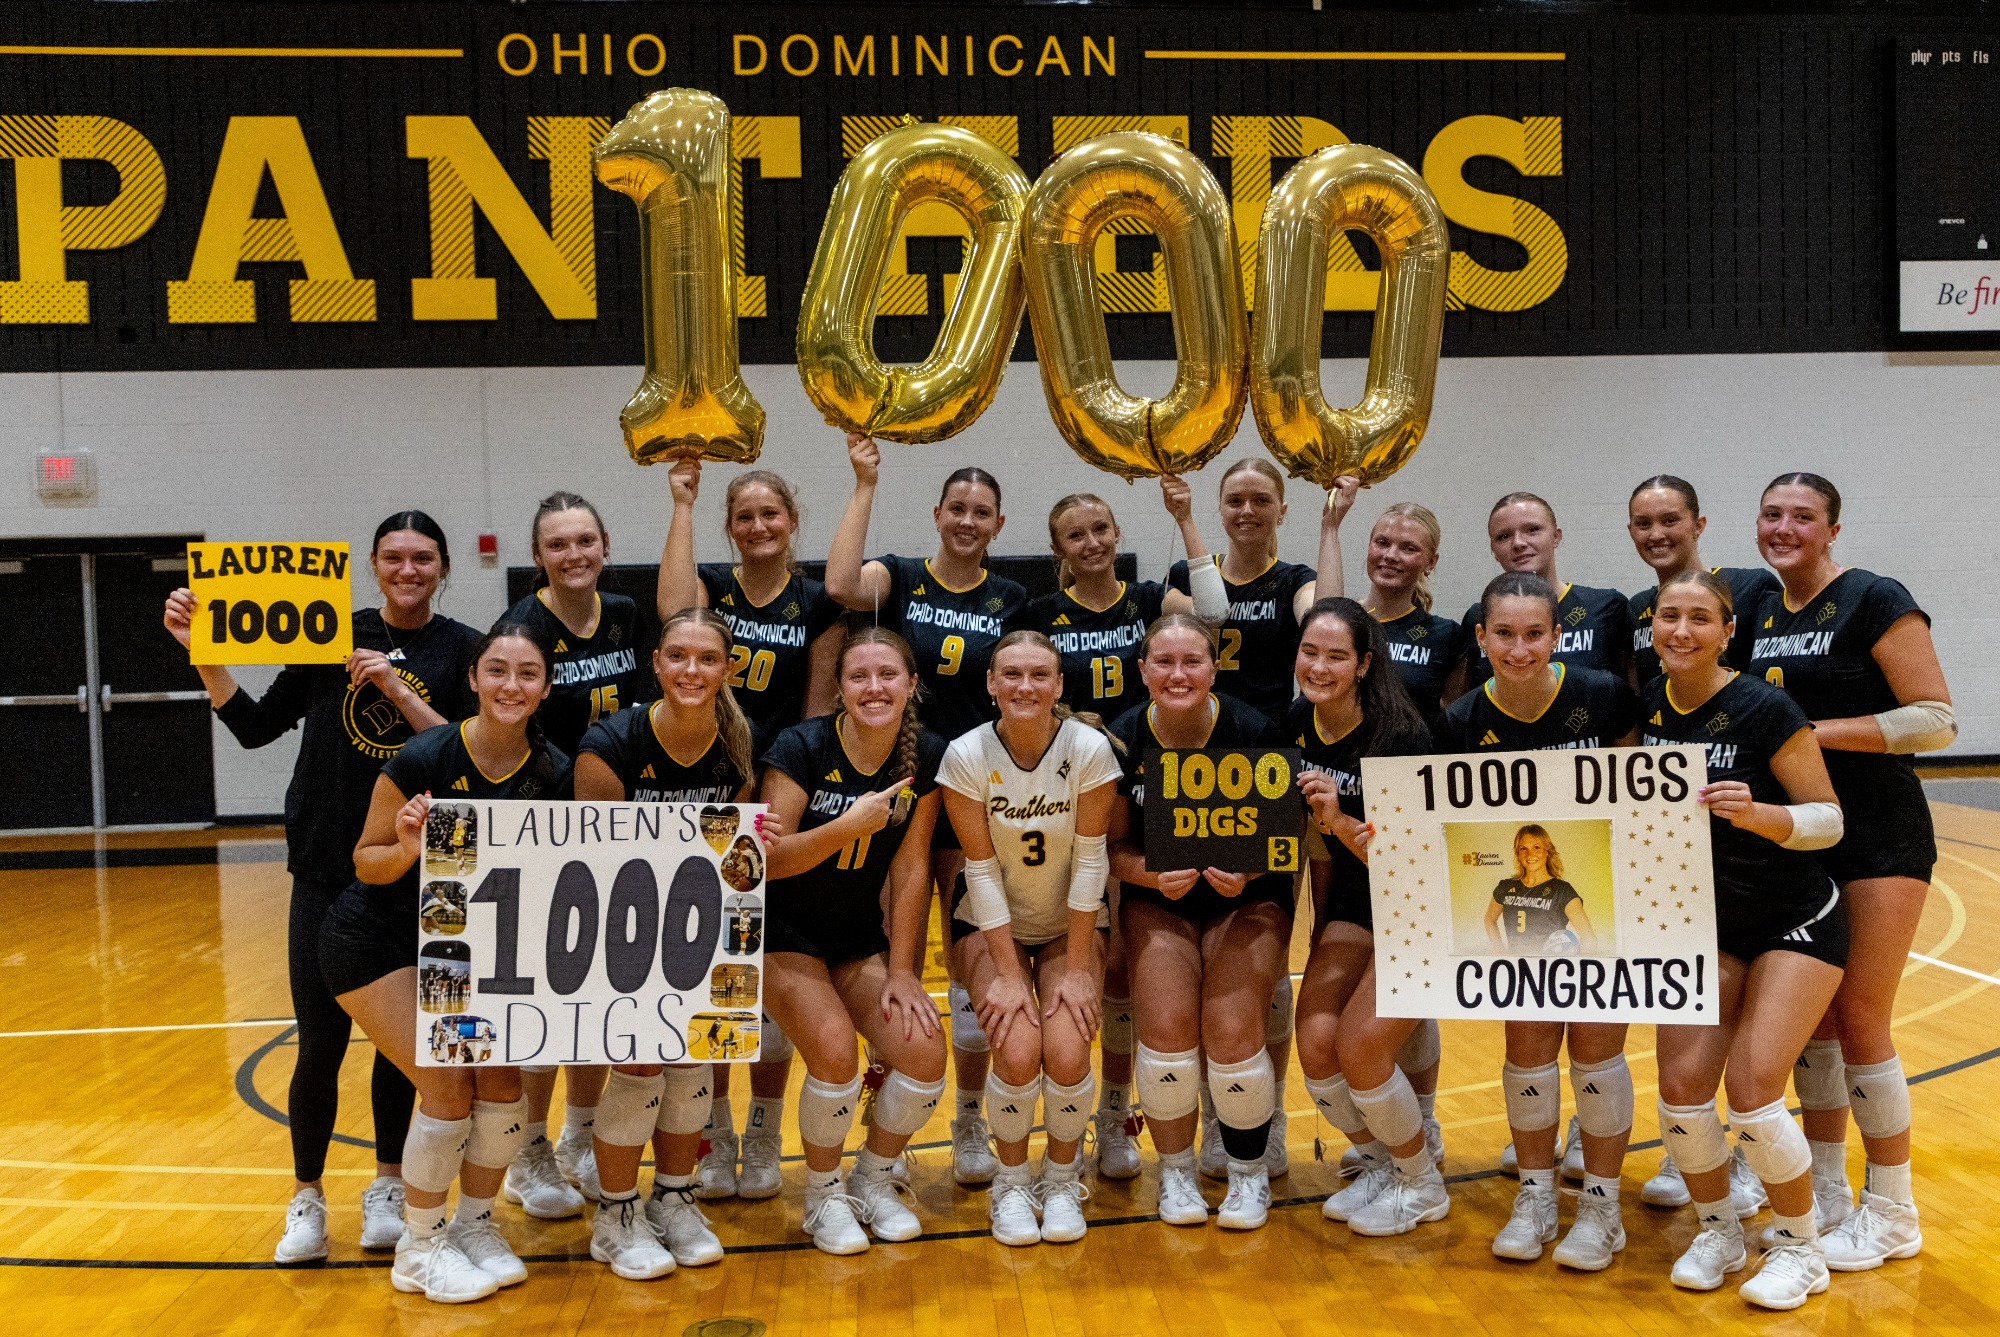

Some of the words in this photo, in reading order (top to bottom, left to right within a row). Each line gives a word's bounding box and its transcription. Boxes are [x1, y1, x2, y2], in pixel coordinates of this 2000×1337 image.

[498, 33, 667, 77] OHIO
[733, 34, 1117, 77] DOMINICAN
[1911, 50, 1932, 65] plyr
[1942, 51, 1961, 65] pts
[1973, 51, 1989, 63] fls
[594, 87, 1450, 487] 1000
[1936, 283, 1968, 305] Be
[190, 545, 349, 579] LAUREN
[208, 599, 339, 645] 1000
[733, 618, 806, 647] DOMINICAN
[906, 600, 934, 623] OHIO
[934, 608, 1003, 637] DOMINICAN
[1080, 618, 1146, 651] DOMINICAN
[936, 635, 965, 676] 9
[1761, 631, 1835, 658] DOMINICAN
[552, 661, 581, 685] OHIO
[578, 648, 636, 681] DOMINICAN
[725, 644, 776, 692] 20
[1090, 655, 1124, 699] 13
[1160, 752, 1290, 800] 1000
[1416, 758, 1538, 811] 1000
[1575, 752, 1689, 804] DIGS
[810, 789, 843, 815] OHIO
[990, 794, 1071, 819] Panthers
[488, 804, 697, 847] LAUREN'S
[1173, 806, 1258, 838] DIGS
[1021, 830, 1046, 867] 3
[1274, 838, 1292, 867] 3
[469, 856, 722, 995] 1000
[1517, 910, 1527, 933] 3
[1456, 954, 1705, 1012] CONGRATS!
[506, 993, 687, 1063] DIGS
